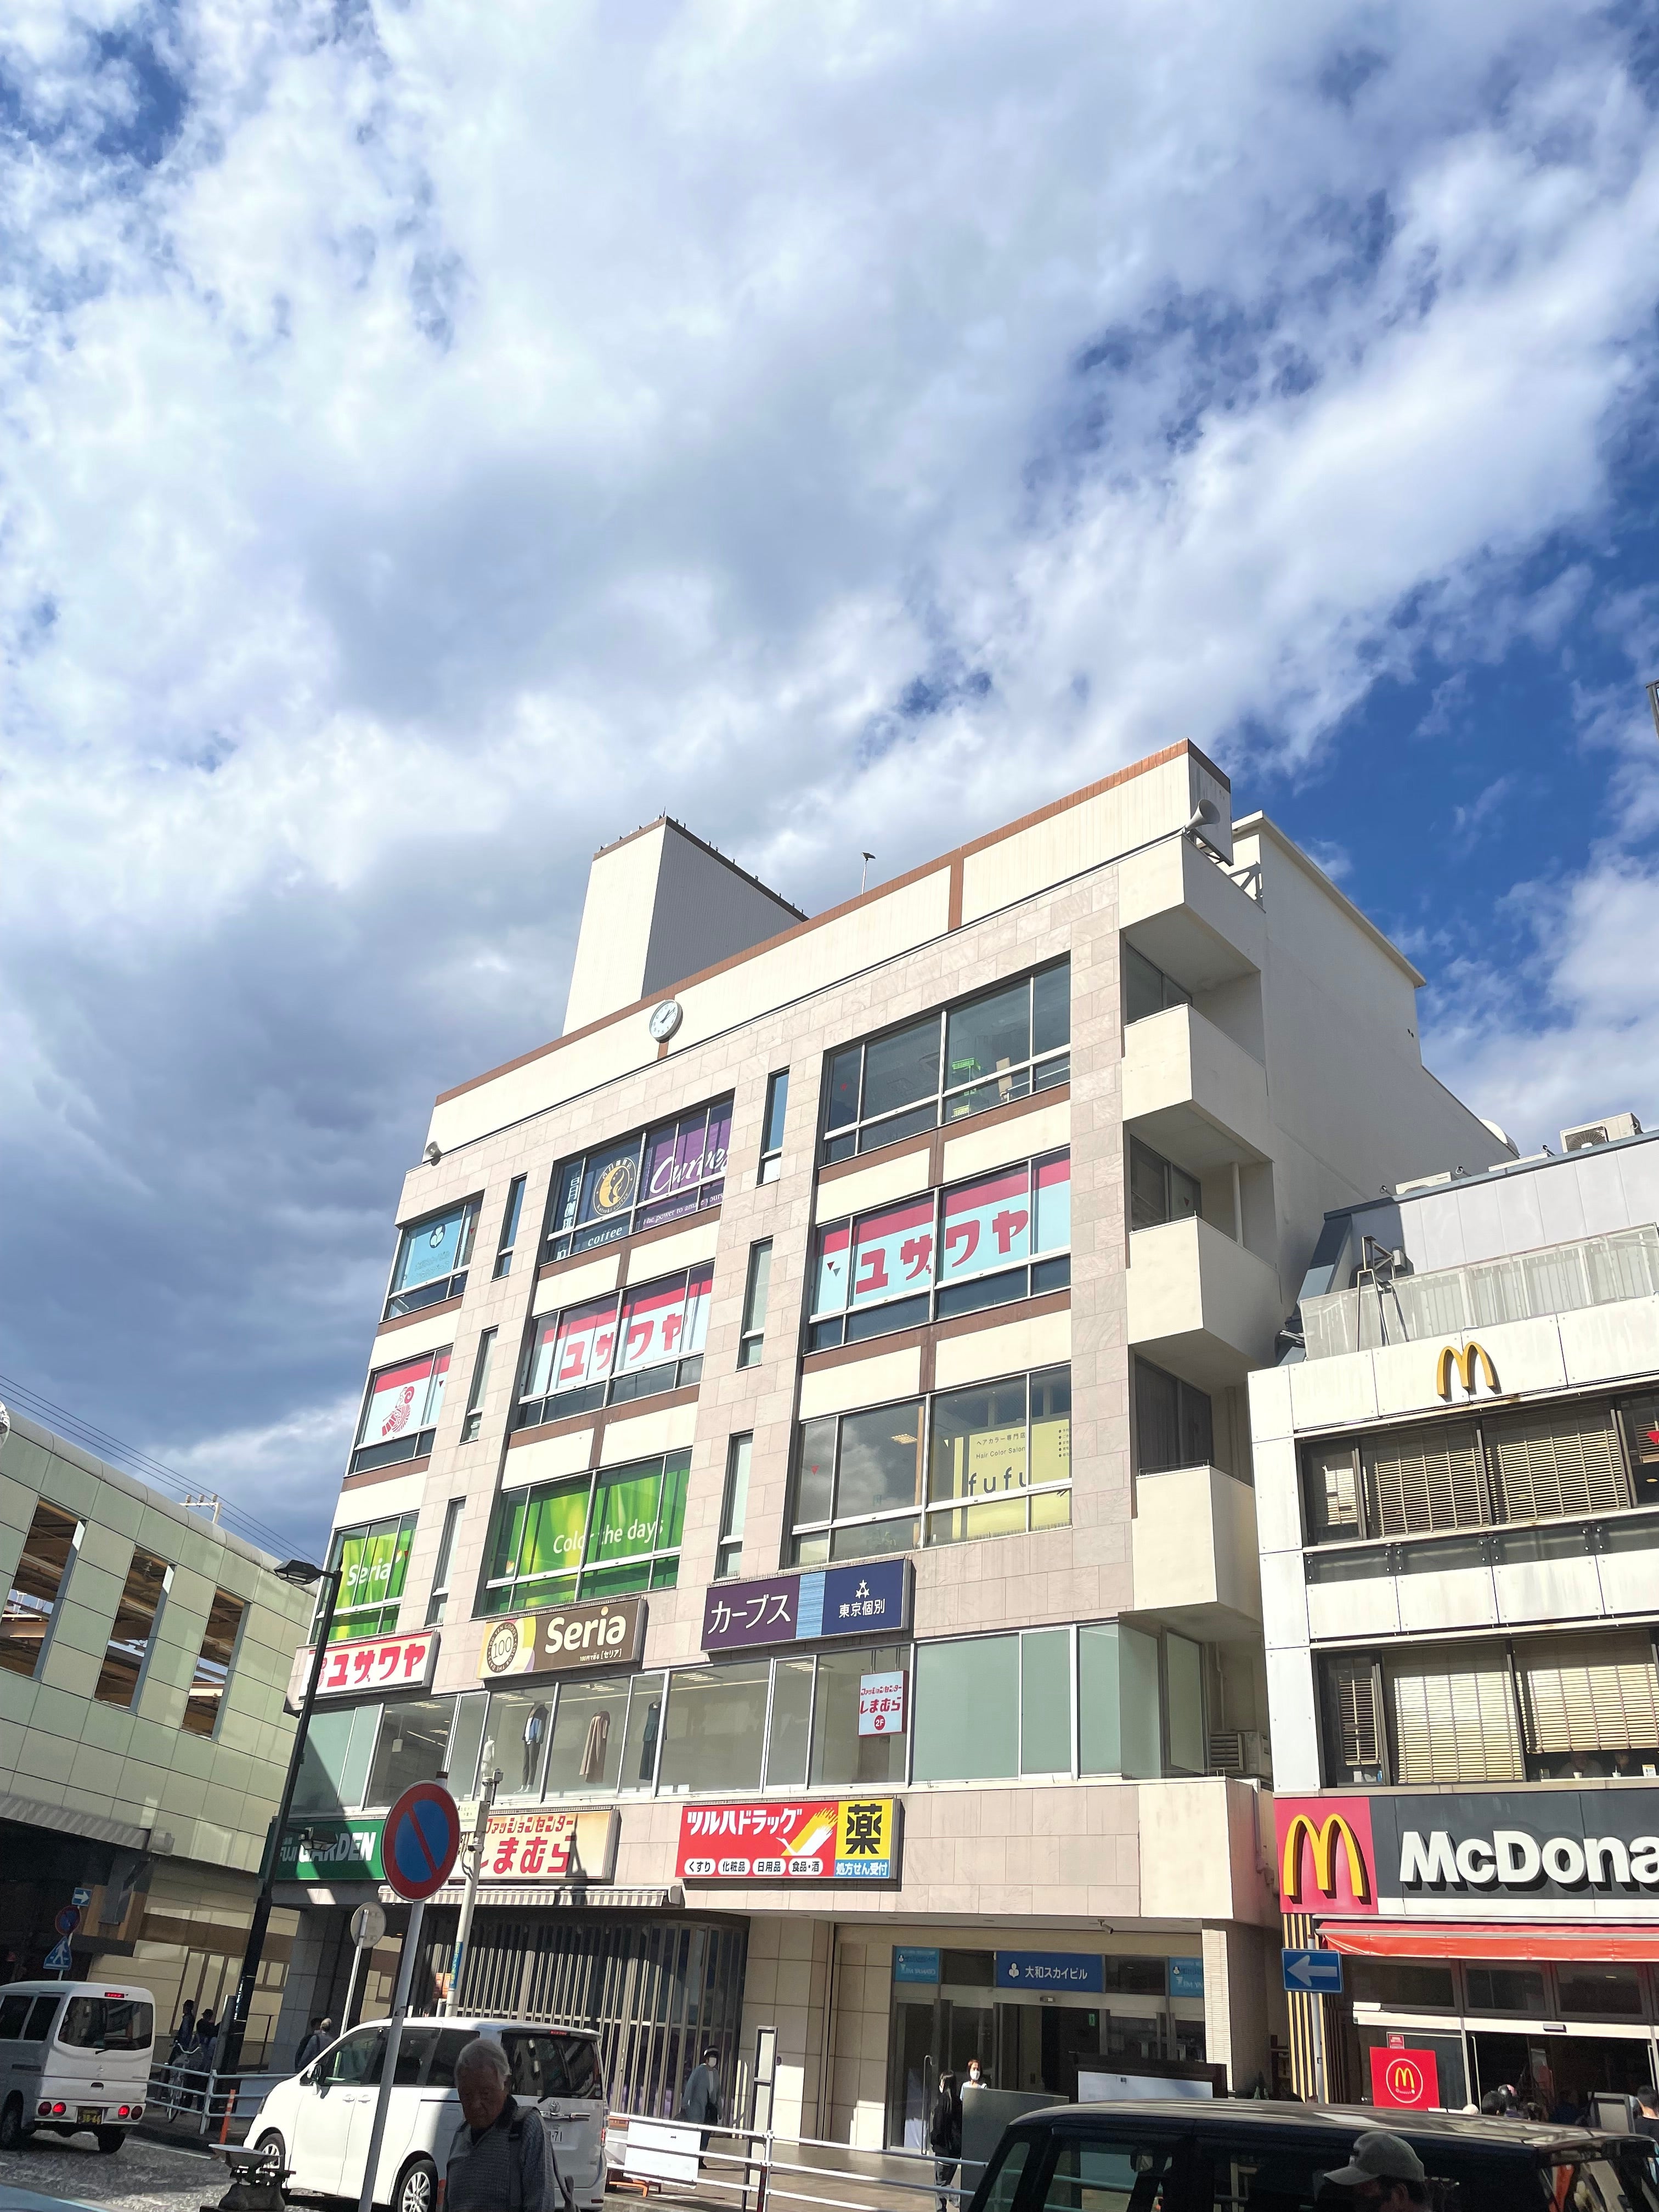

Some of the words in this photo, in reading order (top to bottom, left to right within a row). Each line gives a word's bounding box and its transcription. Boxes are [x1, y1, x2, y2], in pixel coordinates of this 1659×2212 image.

[655, 1210, 675, 1223] power
[588, 1227, 623, 1246] coffee
[856, 1210, 1028, 1295] ユザワヤ
[977, 1432, 1025, 1445] ヘアカラー専門店
[968, 1466, 1026, 1497] fufu
[598, 1524, 623, 1545] he
[346, 1558, 392, 1587] Seria
[707, 1594, 792, 1635] カーブス
[838, 1598, 886, 1619] 東京個別
[495, 1626, 504, 1635] YEN
[505, 1624, 517, 1638] GOODS
[545, 1606, 627, 1654] Seria
[493, 1637, 512, 1658] 100
[327, 1644, 426, 1688] ユザワヤ
[860, 1685, 902, 1696] ファッションセンター
[860, 1697, 901, 1714] しまむら
[875, 1718, 884, 1727] 2F
[486, 1815, 574, 1834] ファッションセンター
[687, 1808, 803, 1836] ツルハドラッグ
[845, 1803, 882, 1855] 薬
[481, 1836, 575, 1875] まむら
[689, 1860, 711, 1872] くすり
[722, 1860, 746, 1872] 化粧品
[757, 1860, 781, 1872] 日用品
[792, 1860, 820, 1872] 食品・酒
[835, 1860, 889, 1876] 処方せん受付
[1025, 1965, 1088, 1980] 大和スカイビル
